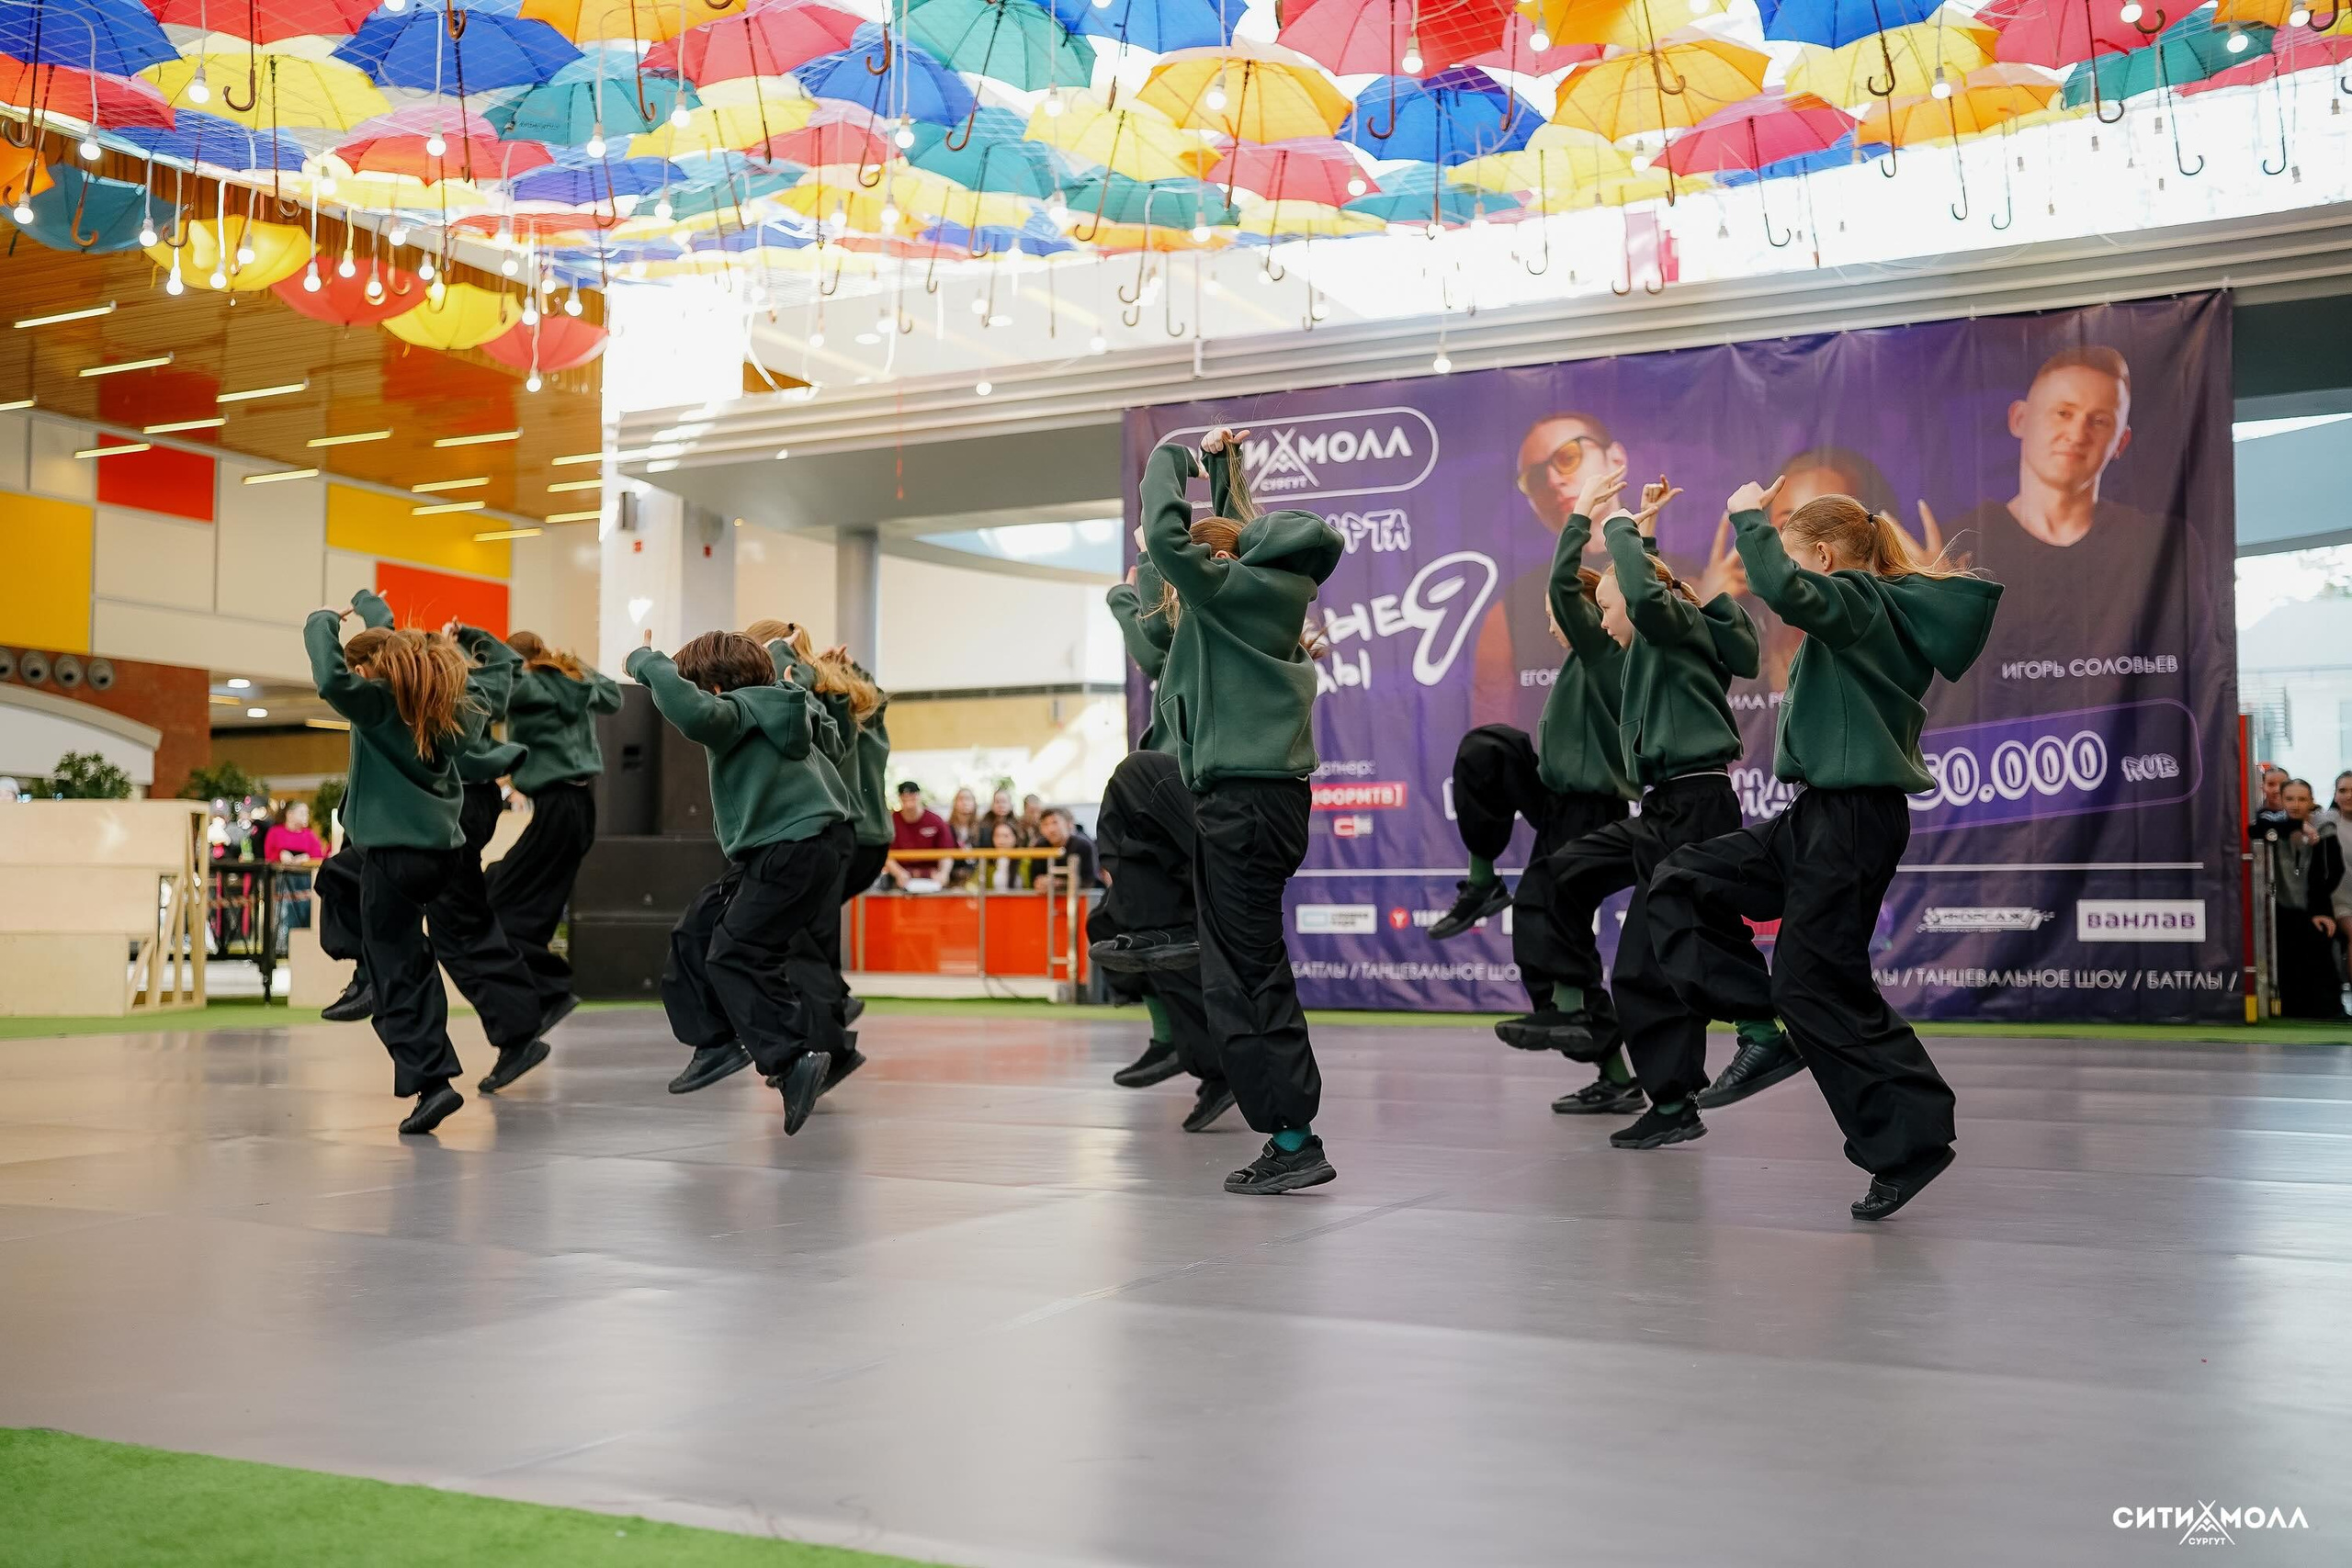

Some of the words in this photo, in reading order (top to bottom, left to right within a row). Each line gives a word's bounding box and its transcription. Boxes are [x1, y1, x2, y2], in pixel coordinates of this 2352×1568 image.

[2001, 660, 2065, 680] ИГОРЬ
[2068, 654, 2178, 678] СОЛОВЬЕВ
[2121, 753, 2179, 783] RUB
[2087, 910, 2197, 930] ванлав
[1359, 962, 1486, 981] ТАНЦЕВАЛЬНОЕ
[1917, 968, 2070, 989] ТАНЦЕВАЛЬНОЕ
[2075, 969, 2128, 990] ШОУ
[2146, 969, 2223, 991] БАТТЛЫ
